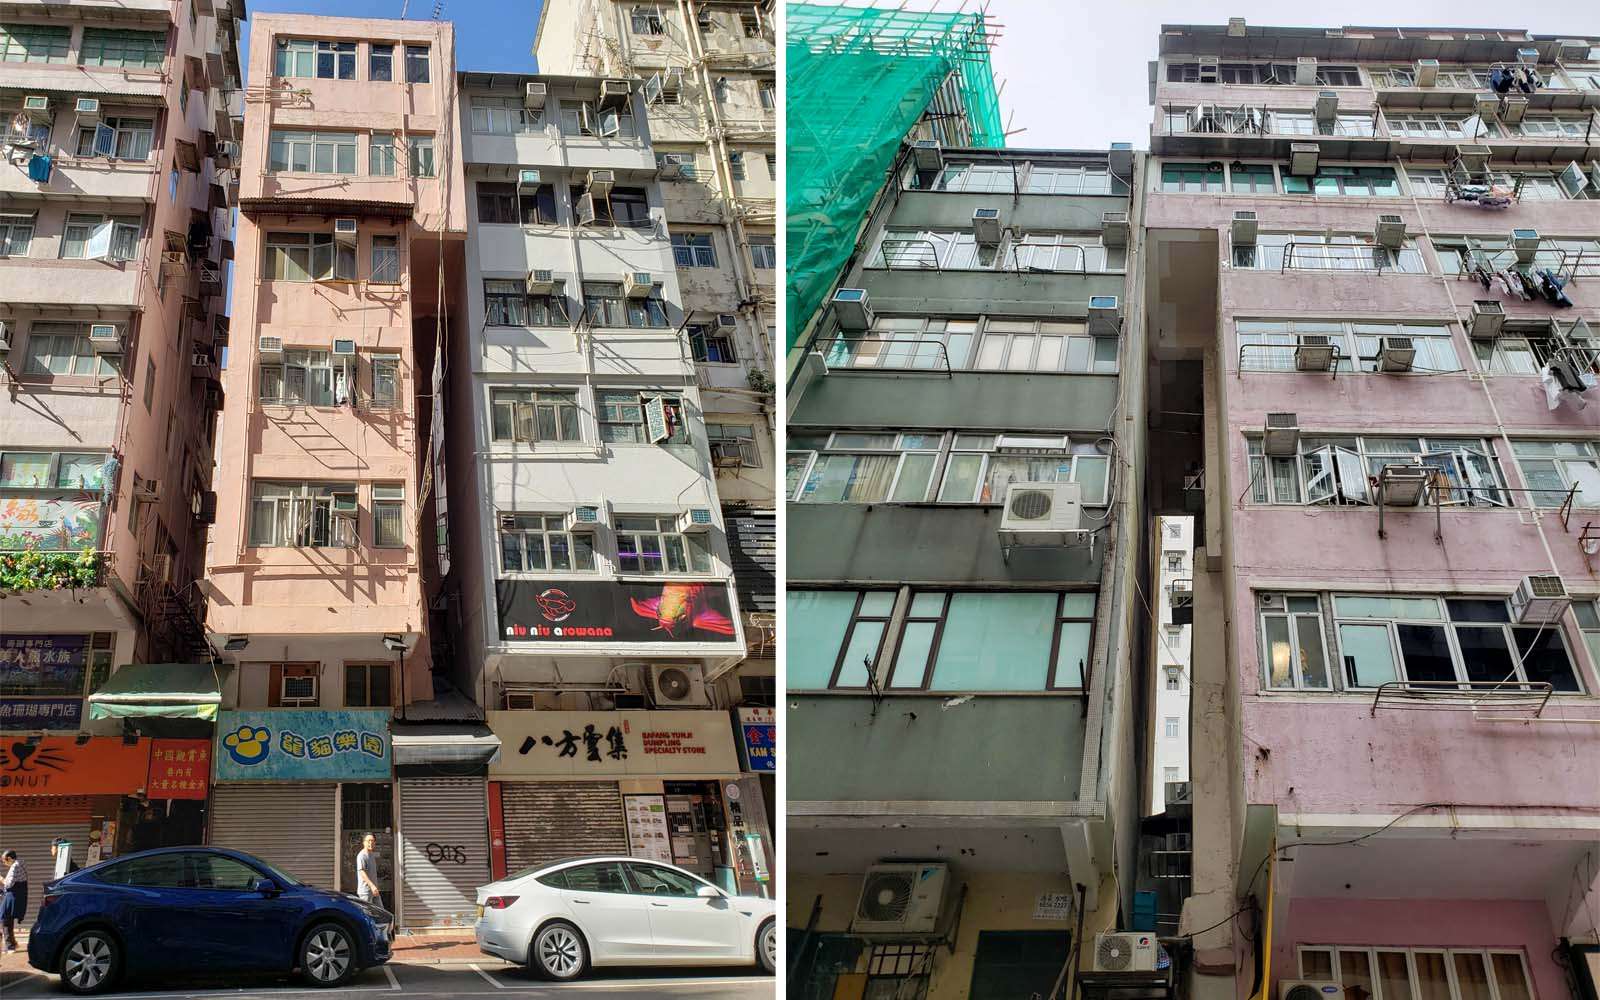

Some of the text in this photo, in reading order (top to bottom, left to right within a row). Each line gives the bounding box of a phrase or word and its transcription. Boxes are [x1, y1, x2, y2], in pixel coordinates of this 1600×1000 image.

[506, 624, 613, 636] niu niu arowana
[518, 724, 628, 762] 八方雲集
